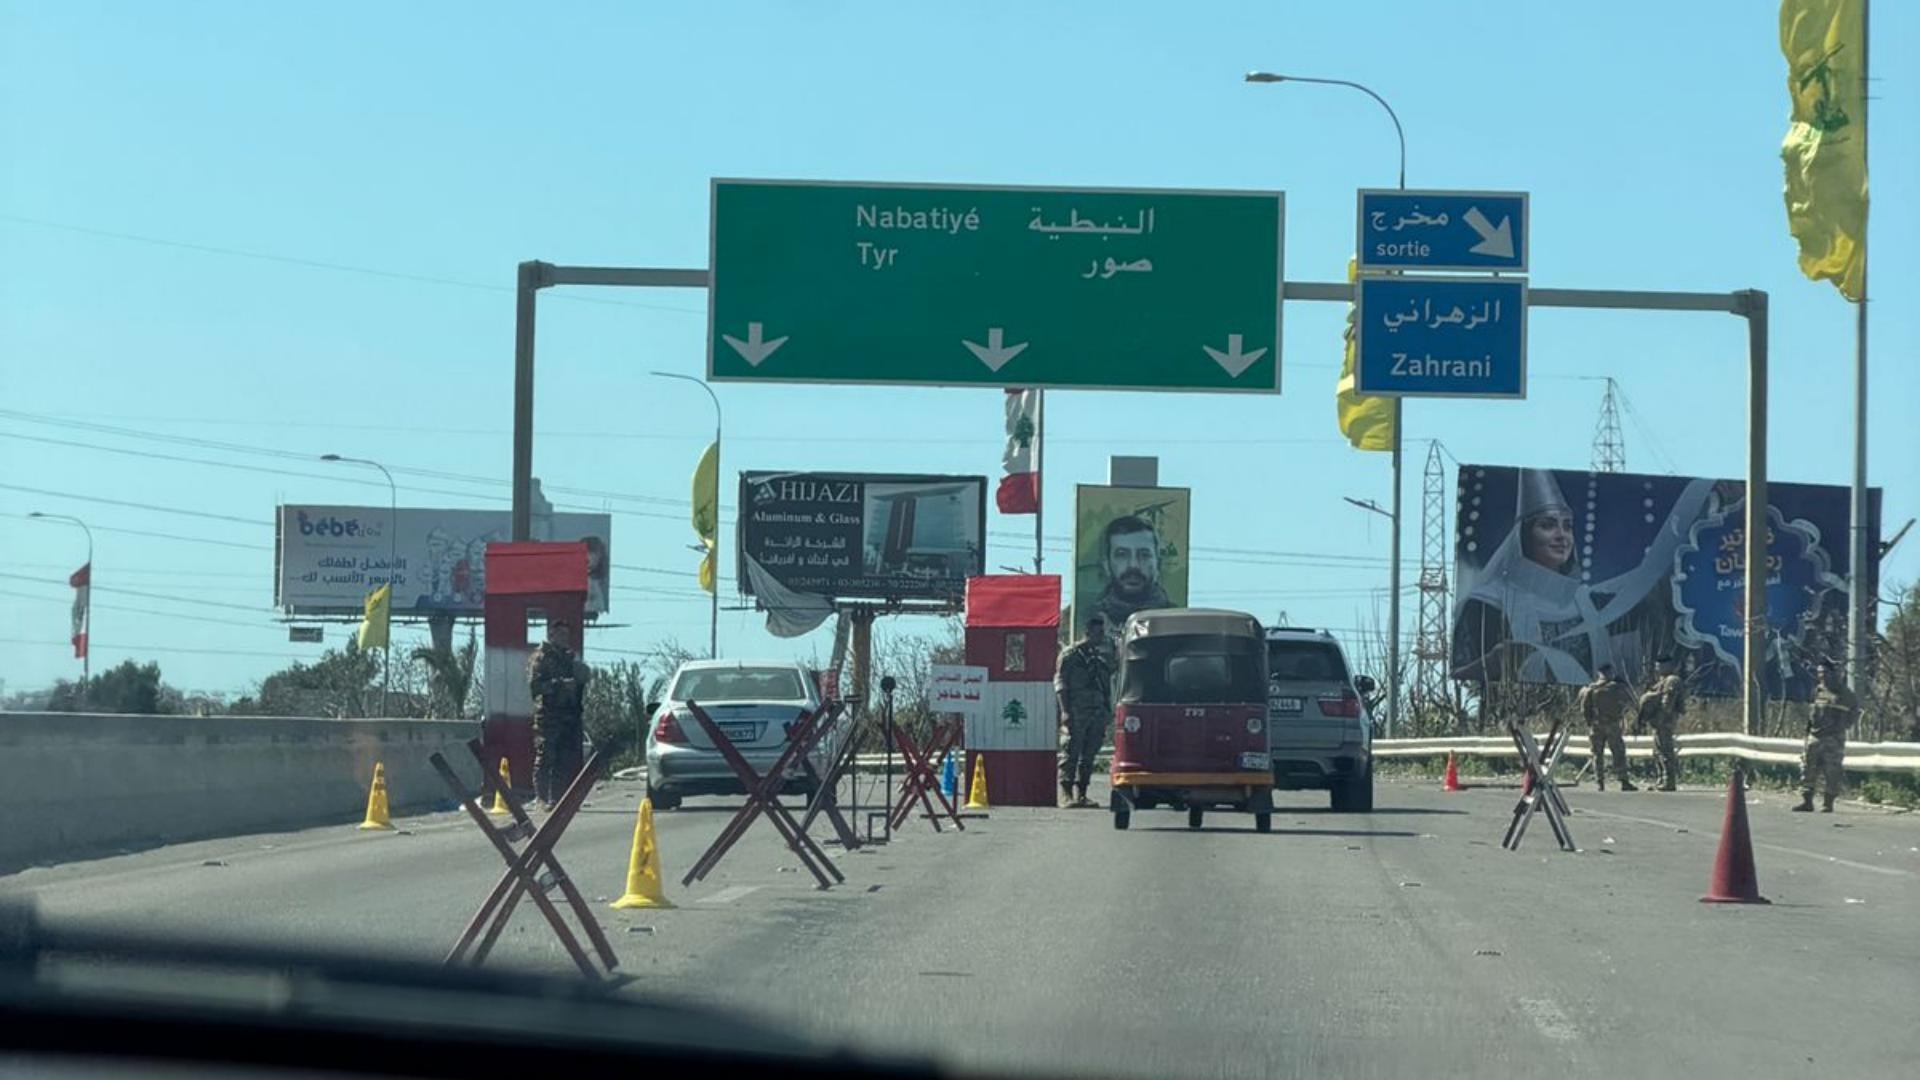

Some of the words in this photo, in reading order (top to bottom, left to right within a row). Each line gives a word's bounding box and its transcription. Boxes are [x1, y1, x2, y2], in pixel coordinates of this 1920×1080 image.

[856, 205, 980, 234] Nabatiyé
[1028, 207, 1155, 241] النبطية
[1371, 205, 1449, 231] مخرج
[857, 242, 898, 269] Tyr
[1376, 241, 1430, 257] sortie
[1081, 256, 1153, 278] صور
[1383, 297, 1501, 333] الزهراني
[1391, 353, 1491, 376] Zahrani
[779, 480, 860, 503] HIJAZI
[752, 510, 812, 524] Aluminum
[815, 512, 826, 524] &
[829, 512, 861, 525] Glass
